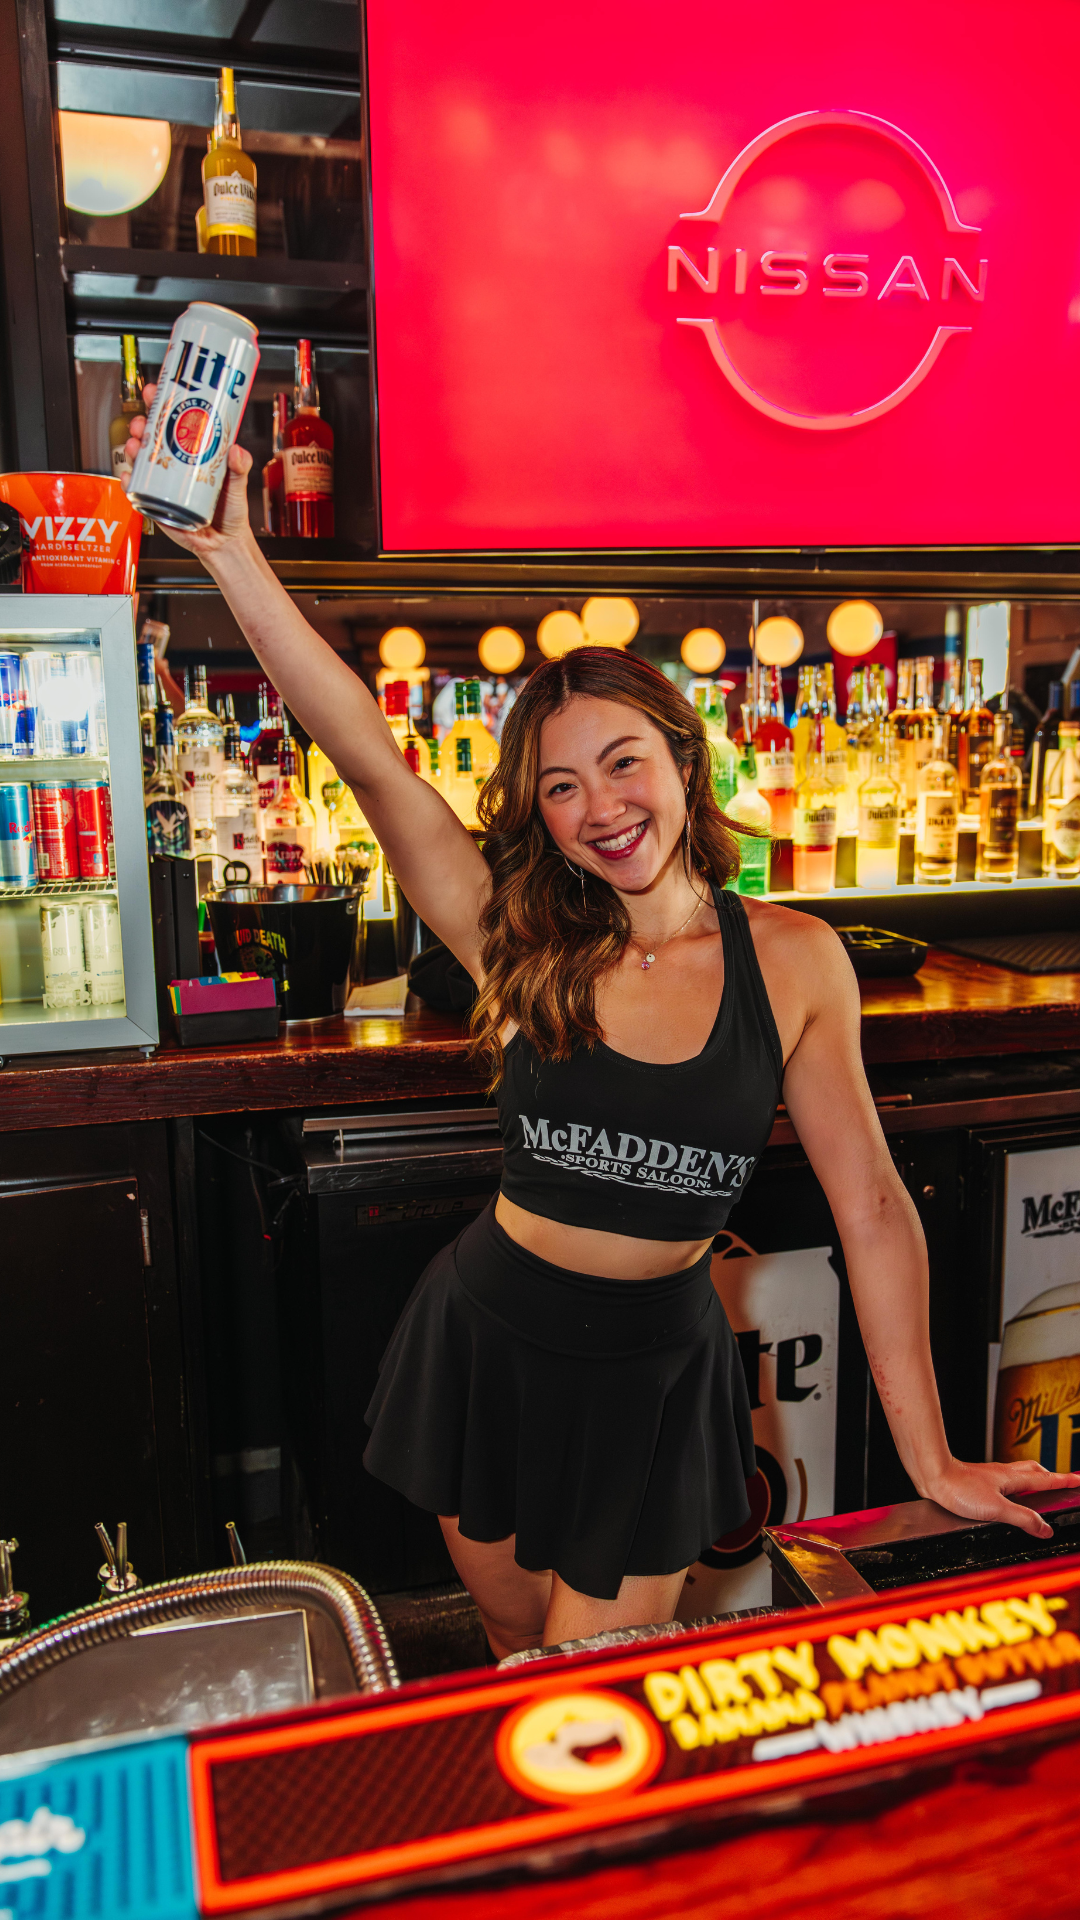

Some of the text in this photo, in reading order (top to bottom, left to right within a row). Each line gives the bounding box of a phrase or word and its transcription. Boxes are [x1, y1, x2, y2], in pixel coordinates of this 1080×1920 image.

[667, 245, 988, 302] NISSAN
[170, 339, 246, 401] Lite
[21, 516, 120, 544] VIZZY
[33, 542, 111, 553] HARD SELTZER
[31, 554, 84, 563] ANTIOXIDANT
[86, 556, 115, 565] VITAMIN
[253, 929, 288, 959] DEATH
[518, 1114, 756, 1188] McFADDEN'S
[562, 1154, 711, 1189] SPORTS SALOON
[644, 1592, 1058, 1722] DIRTY MONKEY
[670, 1688, 827, 1751] BANANA
[813, 1685, 985, 1753] WHISKEY
